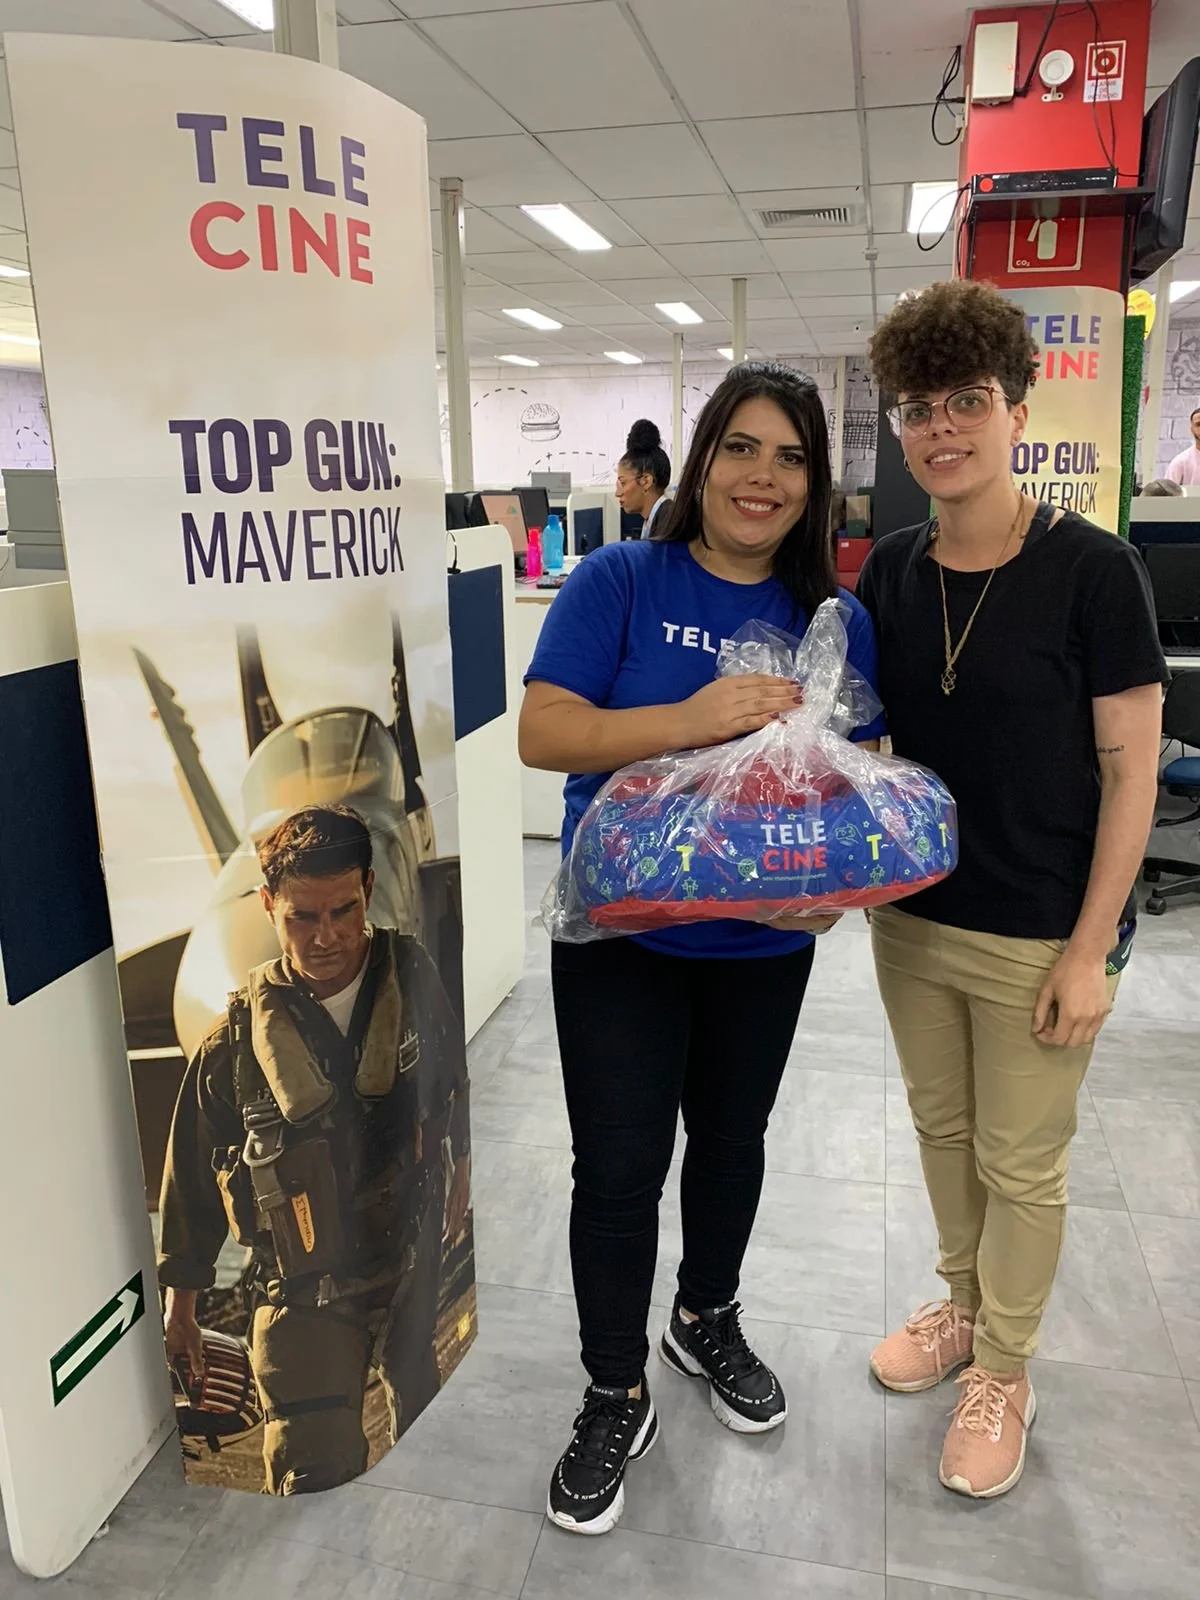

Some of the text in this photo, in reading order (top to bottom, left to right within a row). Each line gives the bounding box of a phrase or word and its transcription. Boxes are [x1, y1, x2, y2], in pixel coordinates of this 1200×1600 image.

[176, 112, 369, 207] TELE
[189, 200, 373, 285] CINE
[1032, 351, 1100, 380] INE
[168, 418, 401, 494] TOP GUN:
[1012, 441, 1100, 475] OP GUN:
[1020, 481, 1098, 514] VERICK
[181, 506, 404, 585] MAVERICK
[760, 820, 827, 846] TELE
[866, 833, 882, 860] T
[676, 845, 694, 871] T
[763, 846, 828, 872] CINE
